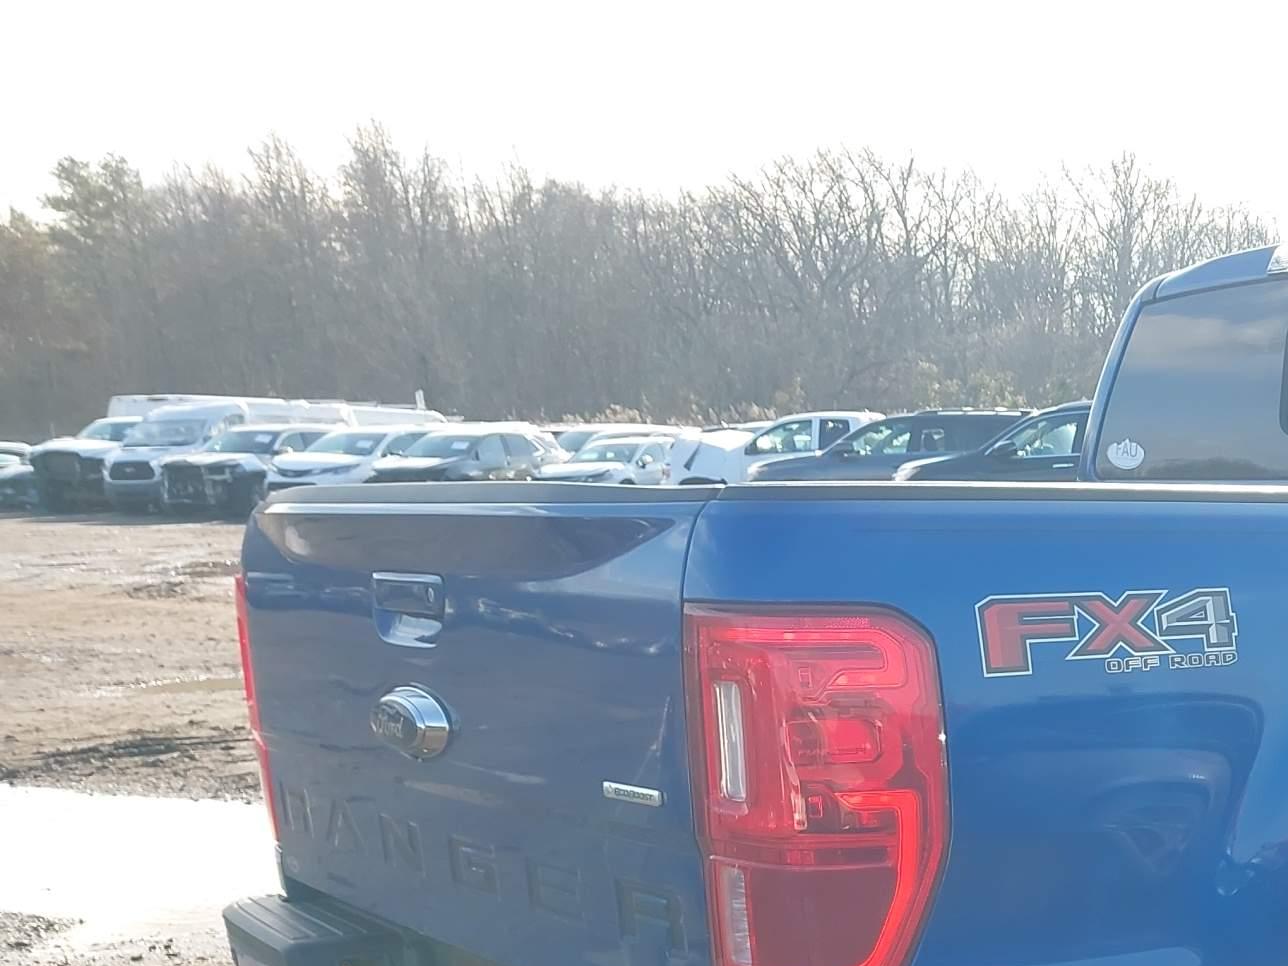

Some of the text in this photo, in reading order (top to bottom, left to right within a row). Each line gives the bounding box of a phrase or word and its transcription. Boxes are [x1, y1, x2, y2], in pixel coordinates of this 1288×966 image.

[974, 586, 1239, 678] FX4
[1104, 650, 1238, 673] OFF ROAD
